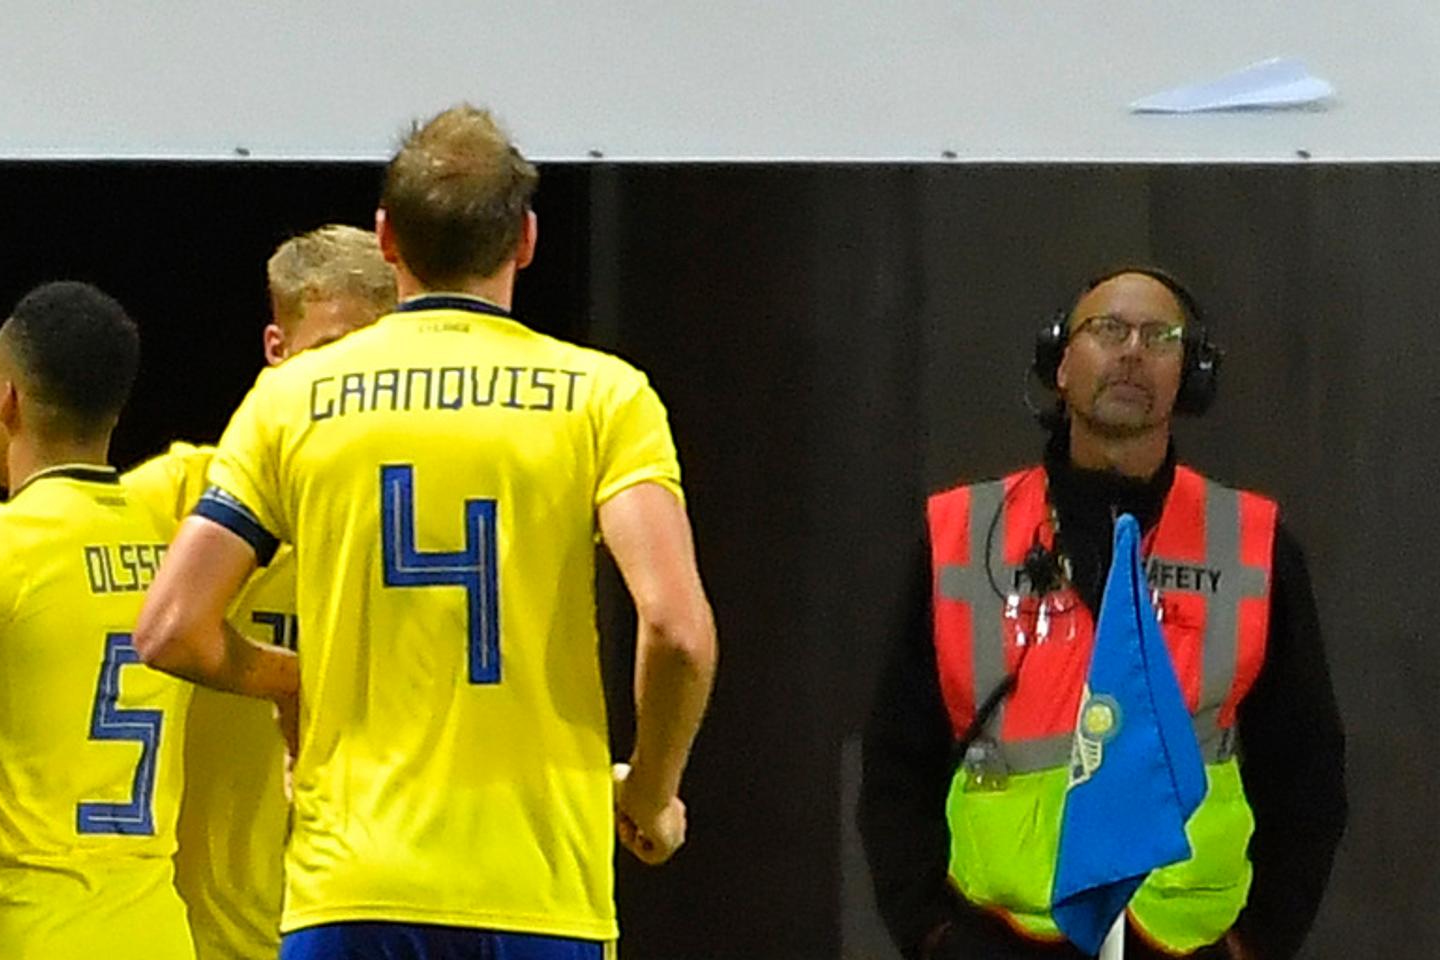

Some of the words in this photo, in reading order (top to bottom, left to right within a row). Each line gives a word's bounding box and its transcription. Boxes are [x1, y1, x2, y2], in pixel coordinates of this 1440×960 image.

[312, 367, 586, 421] GRANQVIST
[85, 544, 169, 593] OLSS
[378, 463, 502, 685] 4
[1142, 559, 1221, 593] AFETY
[76, 632, 164, 835] 5
